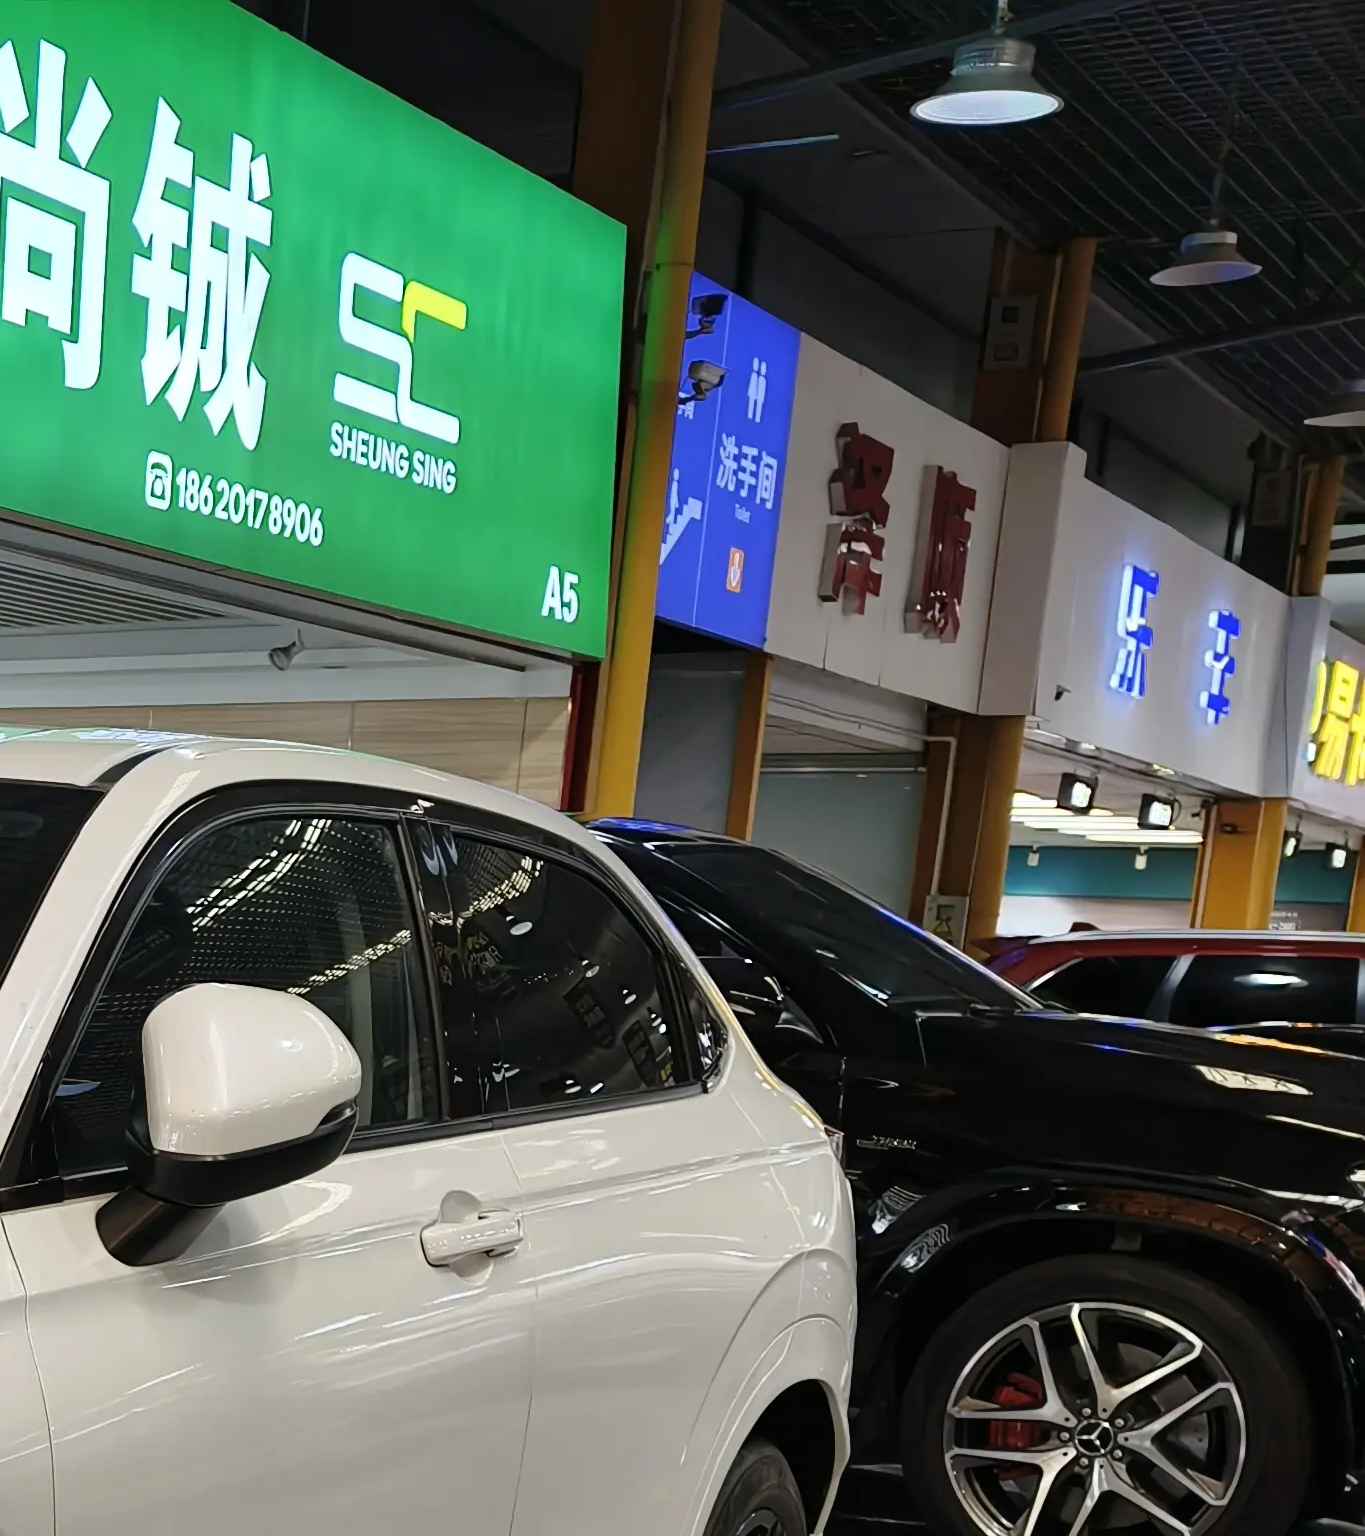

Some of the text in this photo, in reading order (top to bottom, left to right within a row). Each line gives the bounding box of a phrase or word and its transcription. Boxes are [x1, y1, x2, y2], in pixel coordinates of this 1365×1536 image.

[329, 421, 457, 495] SHEUNG SING
[716, 432, 778, 510] 洗手间
[540, 565, 581, 624] A5
